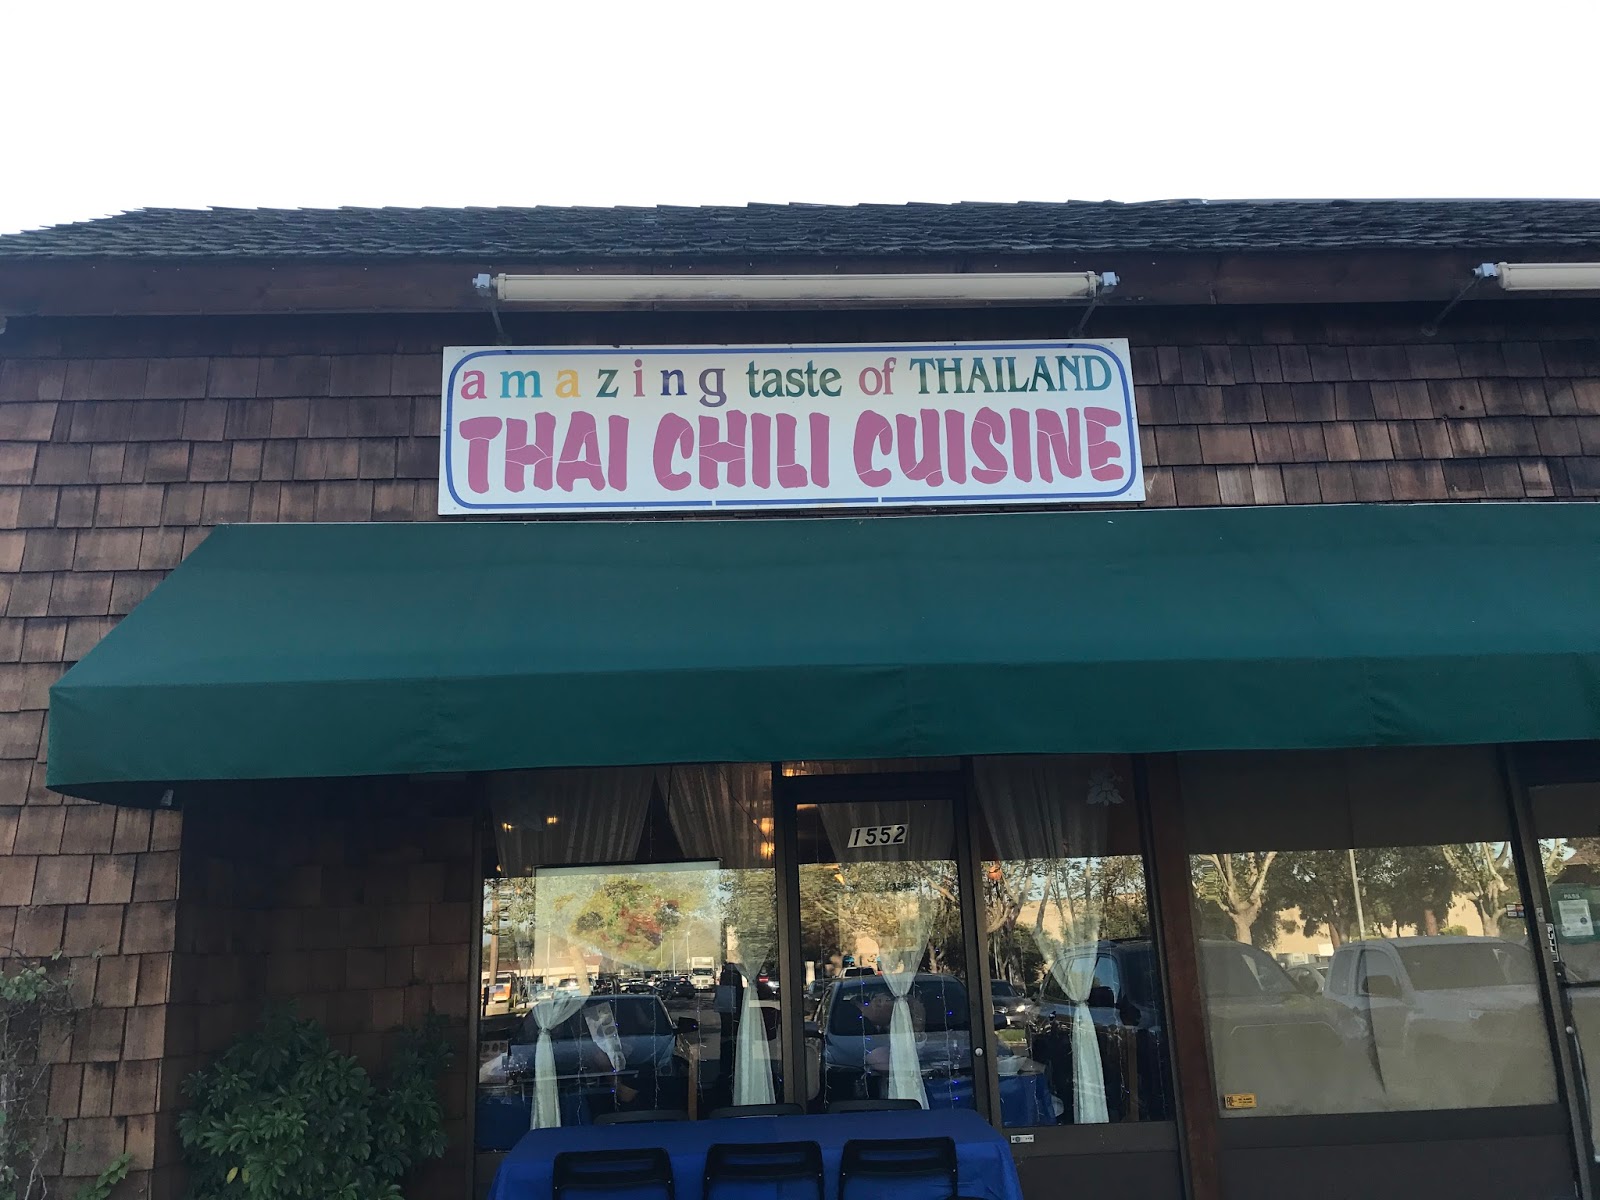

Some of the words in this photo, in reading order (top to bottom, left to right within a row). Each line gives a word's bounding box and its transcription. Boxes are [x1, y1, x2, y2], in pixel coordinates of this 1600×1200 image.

[460, 358, 728, 407] amazing
[745, 359, 842, 398] taste
[858, 357, 897, 396] of
[909, 355, 1112, 394] THAILAND
[459, 410, 631, 493] THAI
[653, 409, 830, 491] CHILI
[853, 406, 1125, 488] CUISINE
[853, 825, 906, 846] 1552
[1547, 926, 1556, 953] PULL
